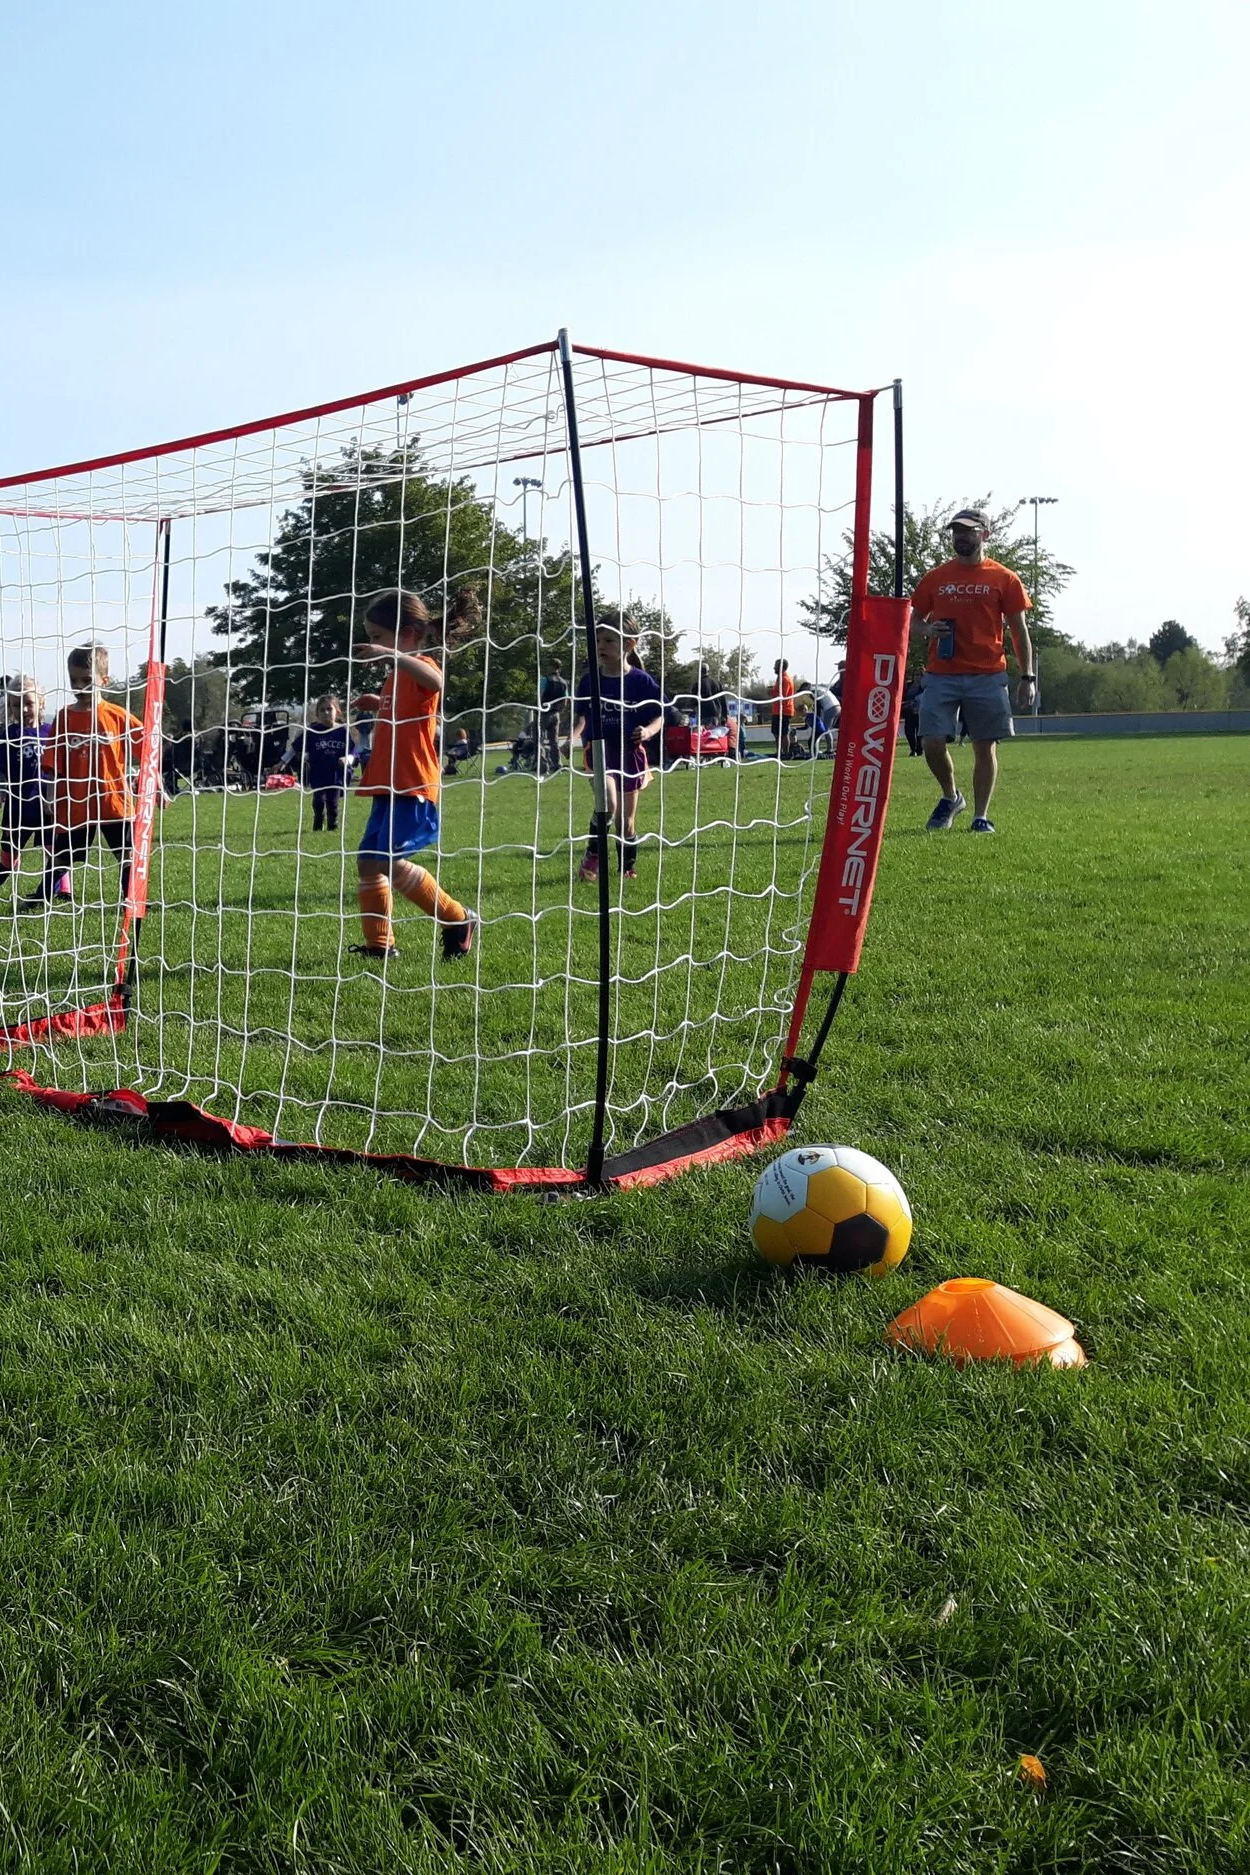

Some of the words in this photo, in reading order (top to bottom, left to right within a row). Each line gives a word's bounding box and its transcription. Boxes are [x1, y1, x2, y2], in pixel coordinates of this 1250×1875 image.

[938, 584, 990, 596] SOCCER
[847, 741, 856, 757] Out
[838, 653, 896, 916] POWERNET
[840, 786, 850, 801] Out
